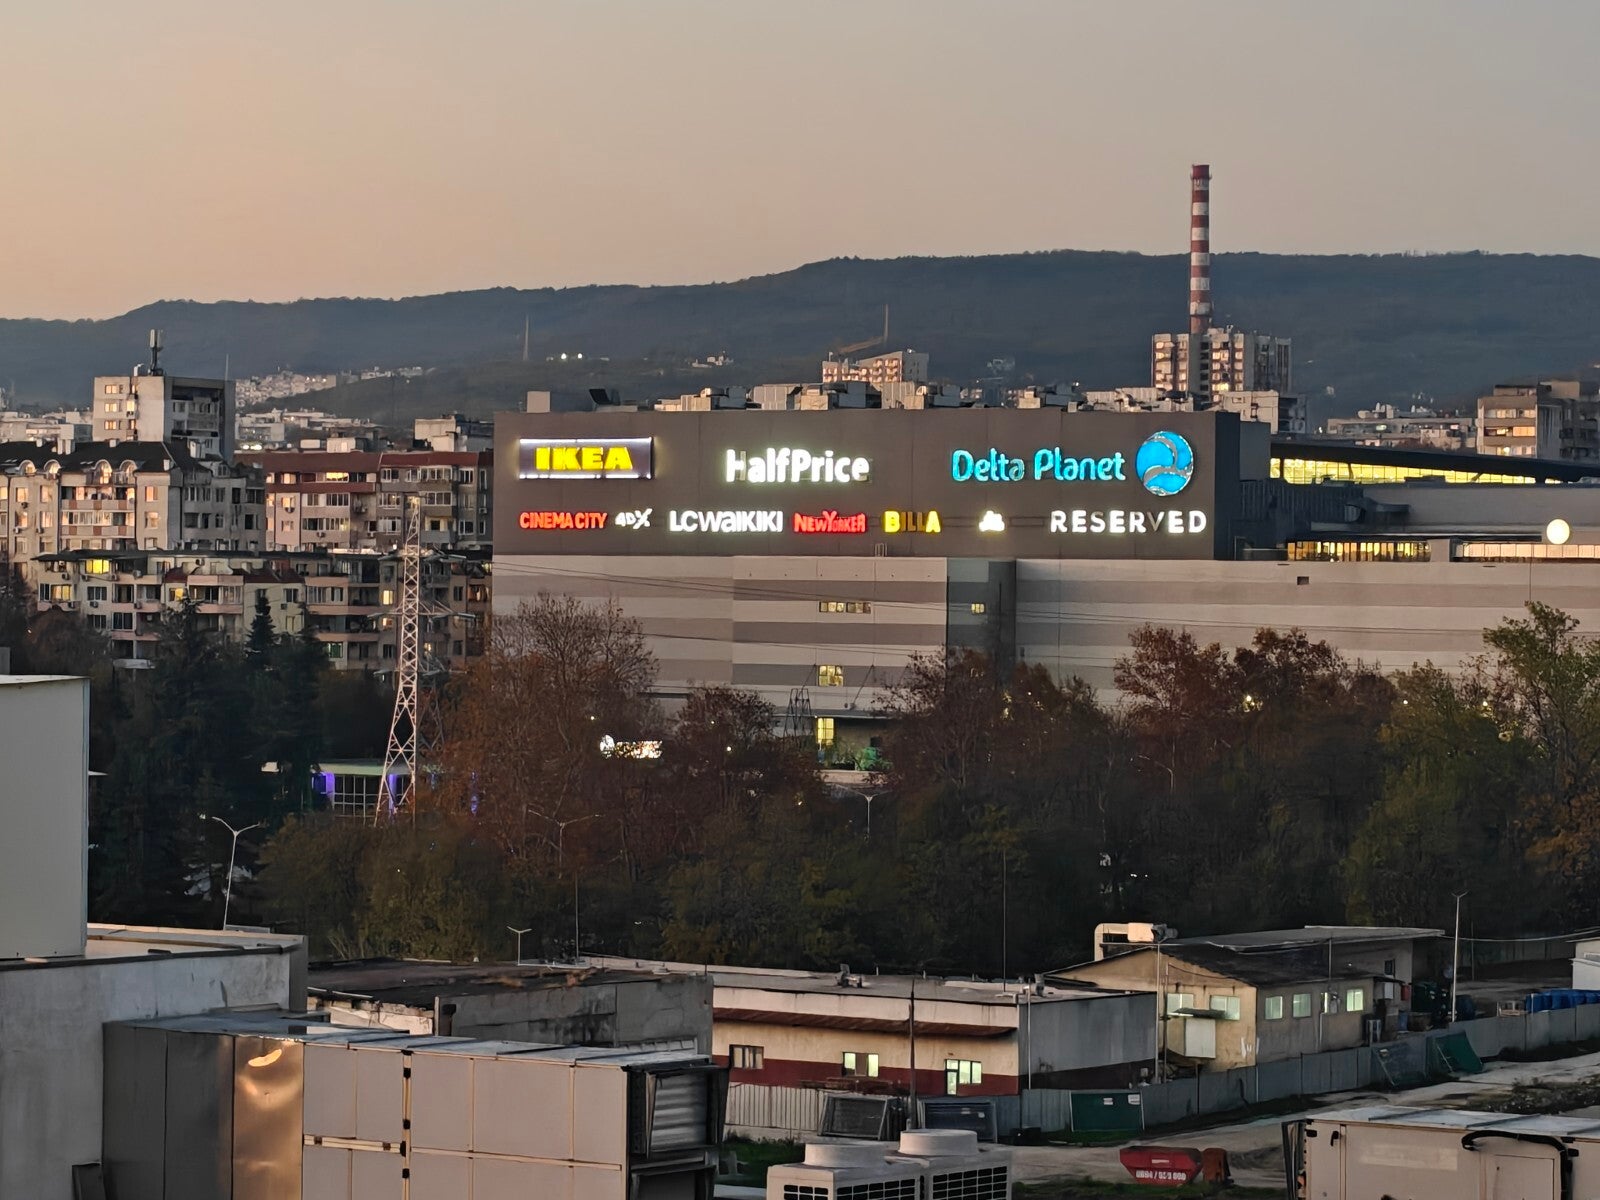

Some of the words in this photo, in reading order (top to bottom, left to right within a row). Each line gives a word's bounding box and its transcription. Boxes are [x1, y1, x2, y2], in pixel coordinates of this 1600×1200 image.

[535, 446, 633, 471] IKEA
[724, 447, 870, 483] HalfPrice
[951, 449, 1026, 482] Delta
[1033, 448, 1126, 482] Planet
[519, 511, 573, 529] CINEMA
[883, 510, 941, 534] BILLA
[1050, 510, 1207, 534] RESERVED
